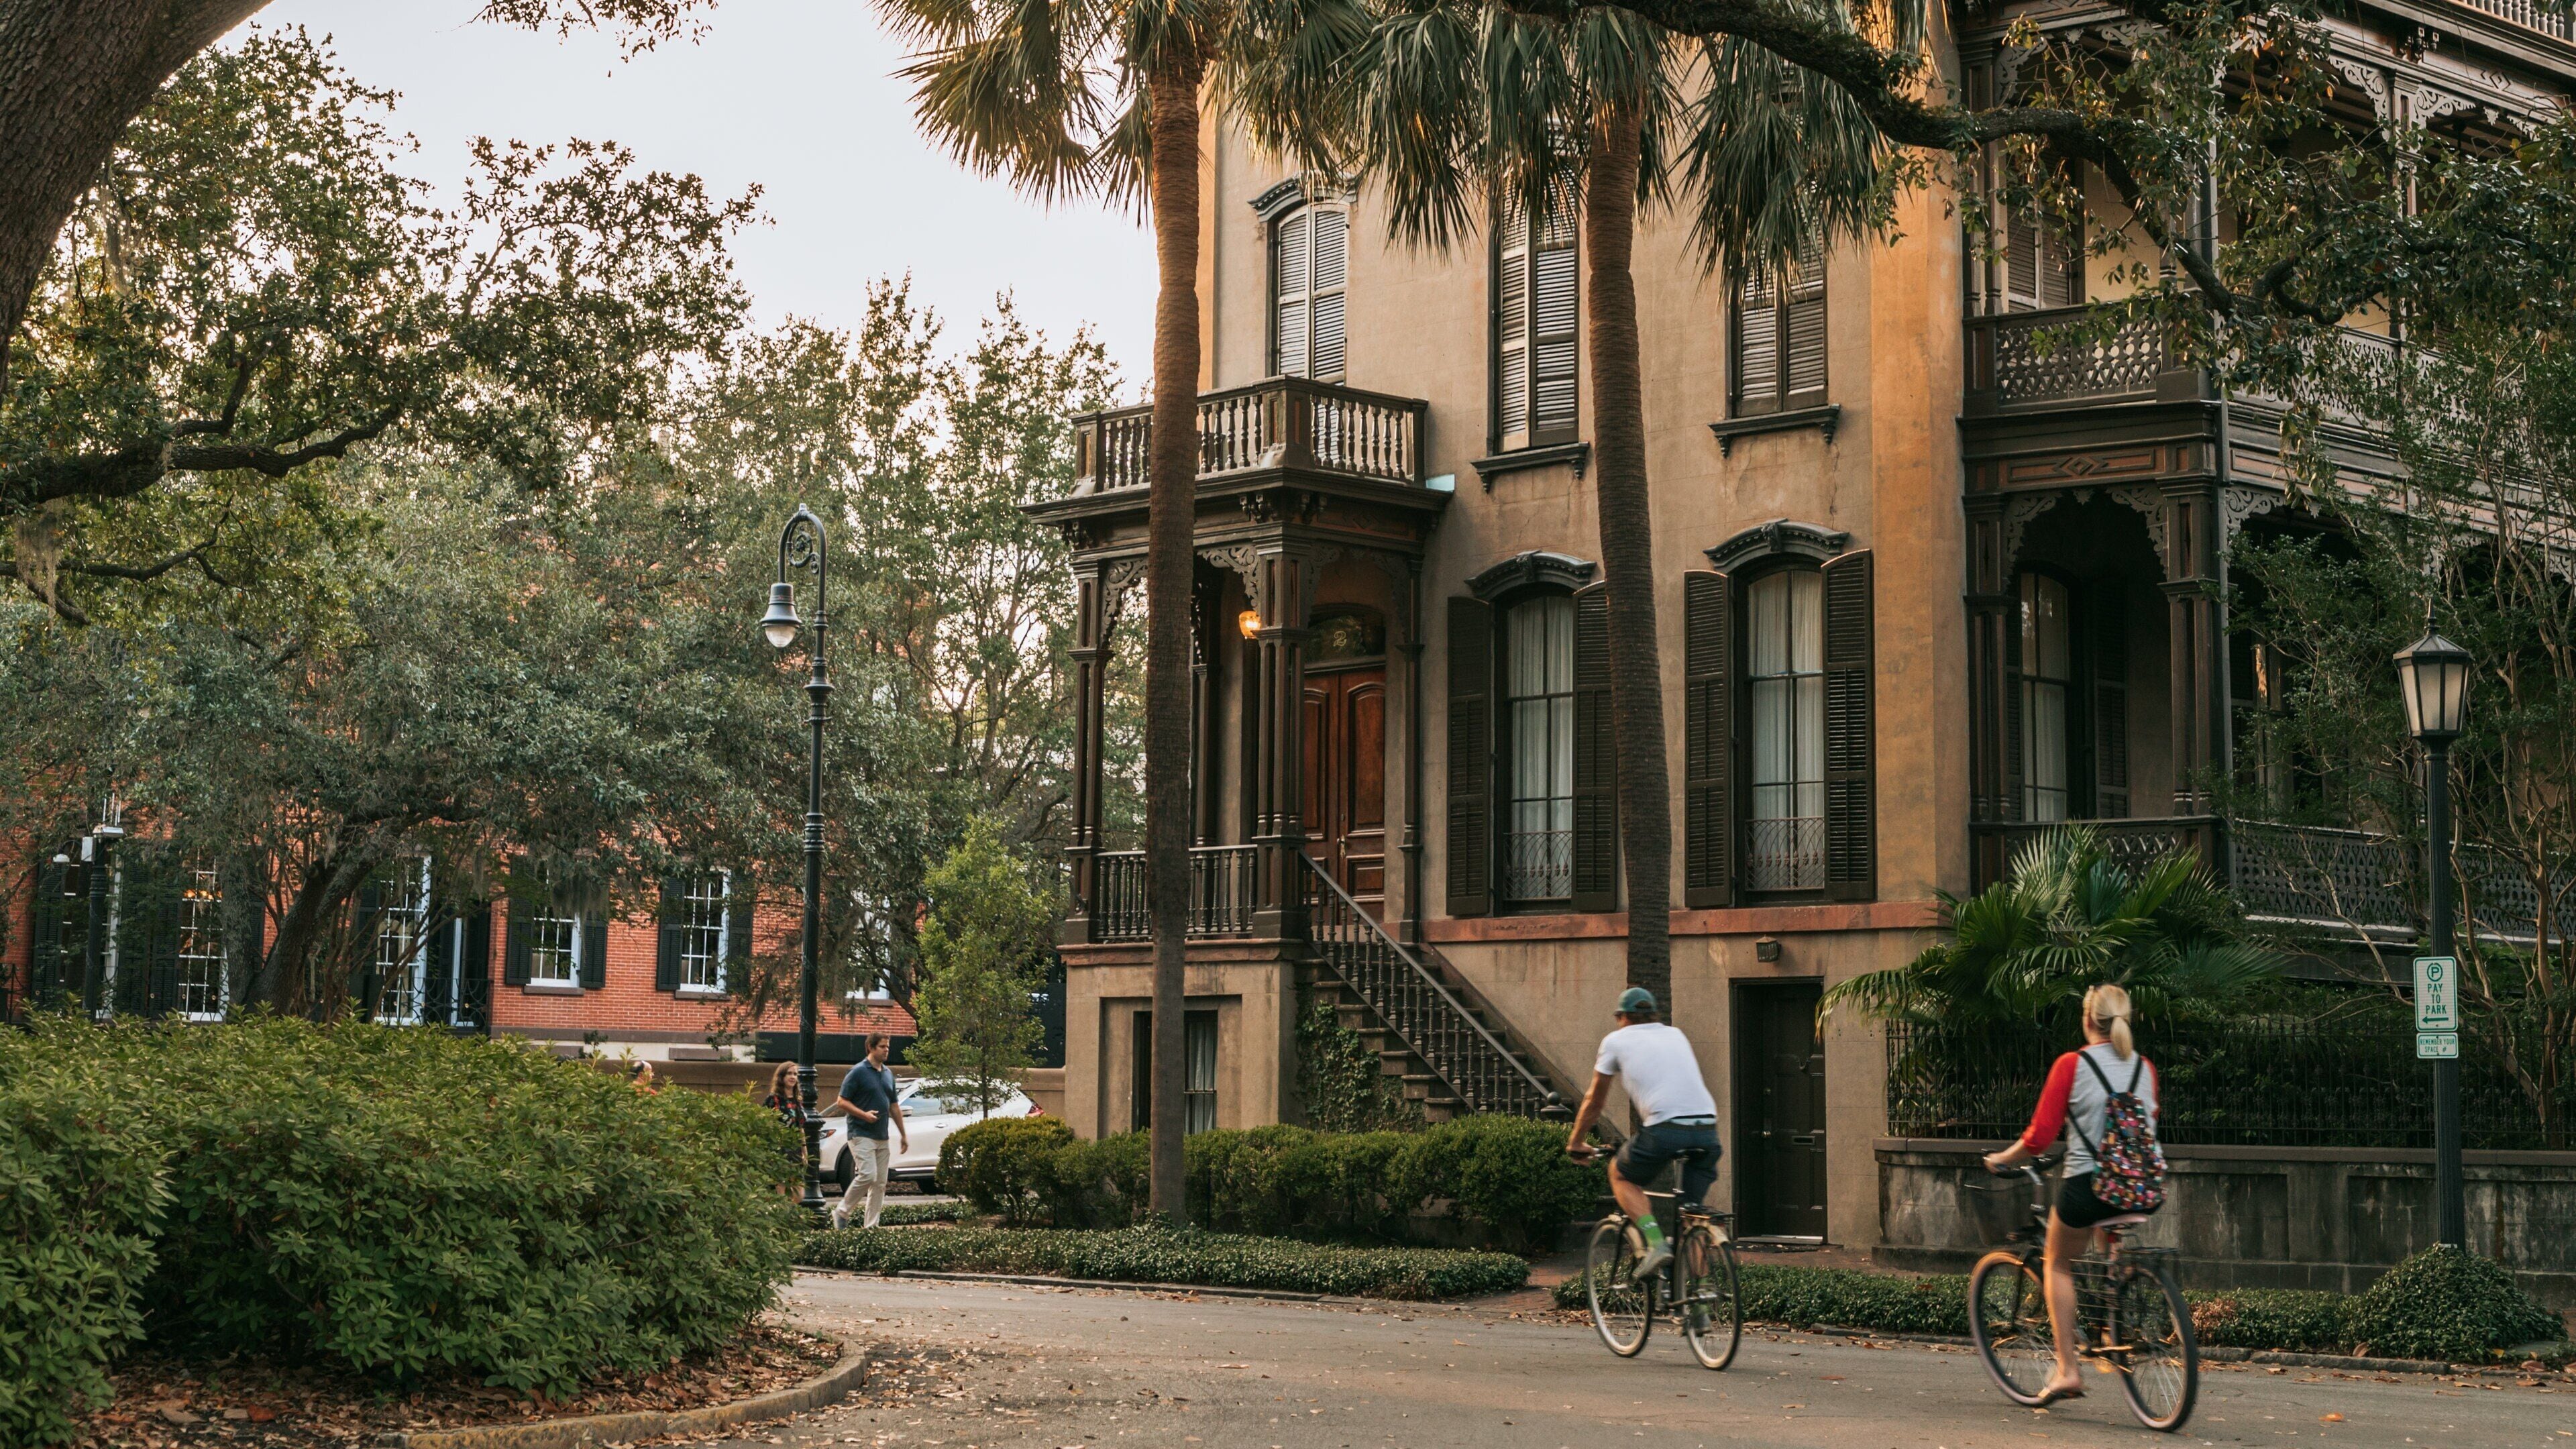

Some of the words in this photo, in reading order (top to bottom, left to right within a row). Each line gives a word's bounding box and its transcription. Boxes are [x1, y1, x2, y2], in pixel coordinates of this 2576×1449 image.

[1333, 631, 1347, 647] 2
[2431, 967, 2439, 977] P
[2428, 983, 2443, 993] PAY
[2431, 994, 2441, 1004] TO
[2426, 1005, 2447, 1014] PARK
